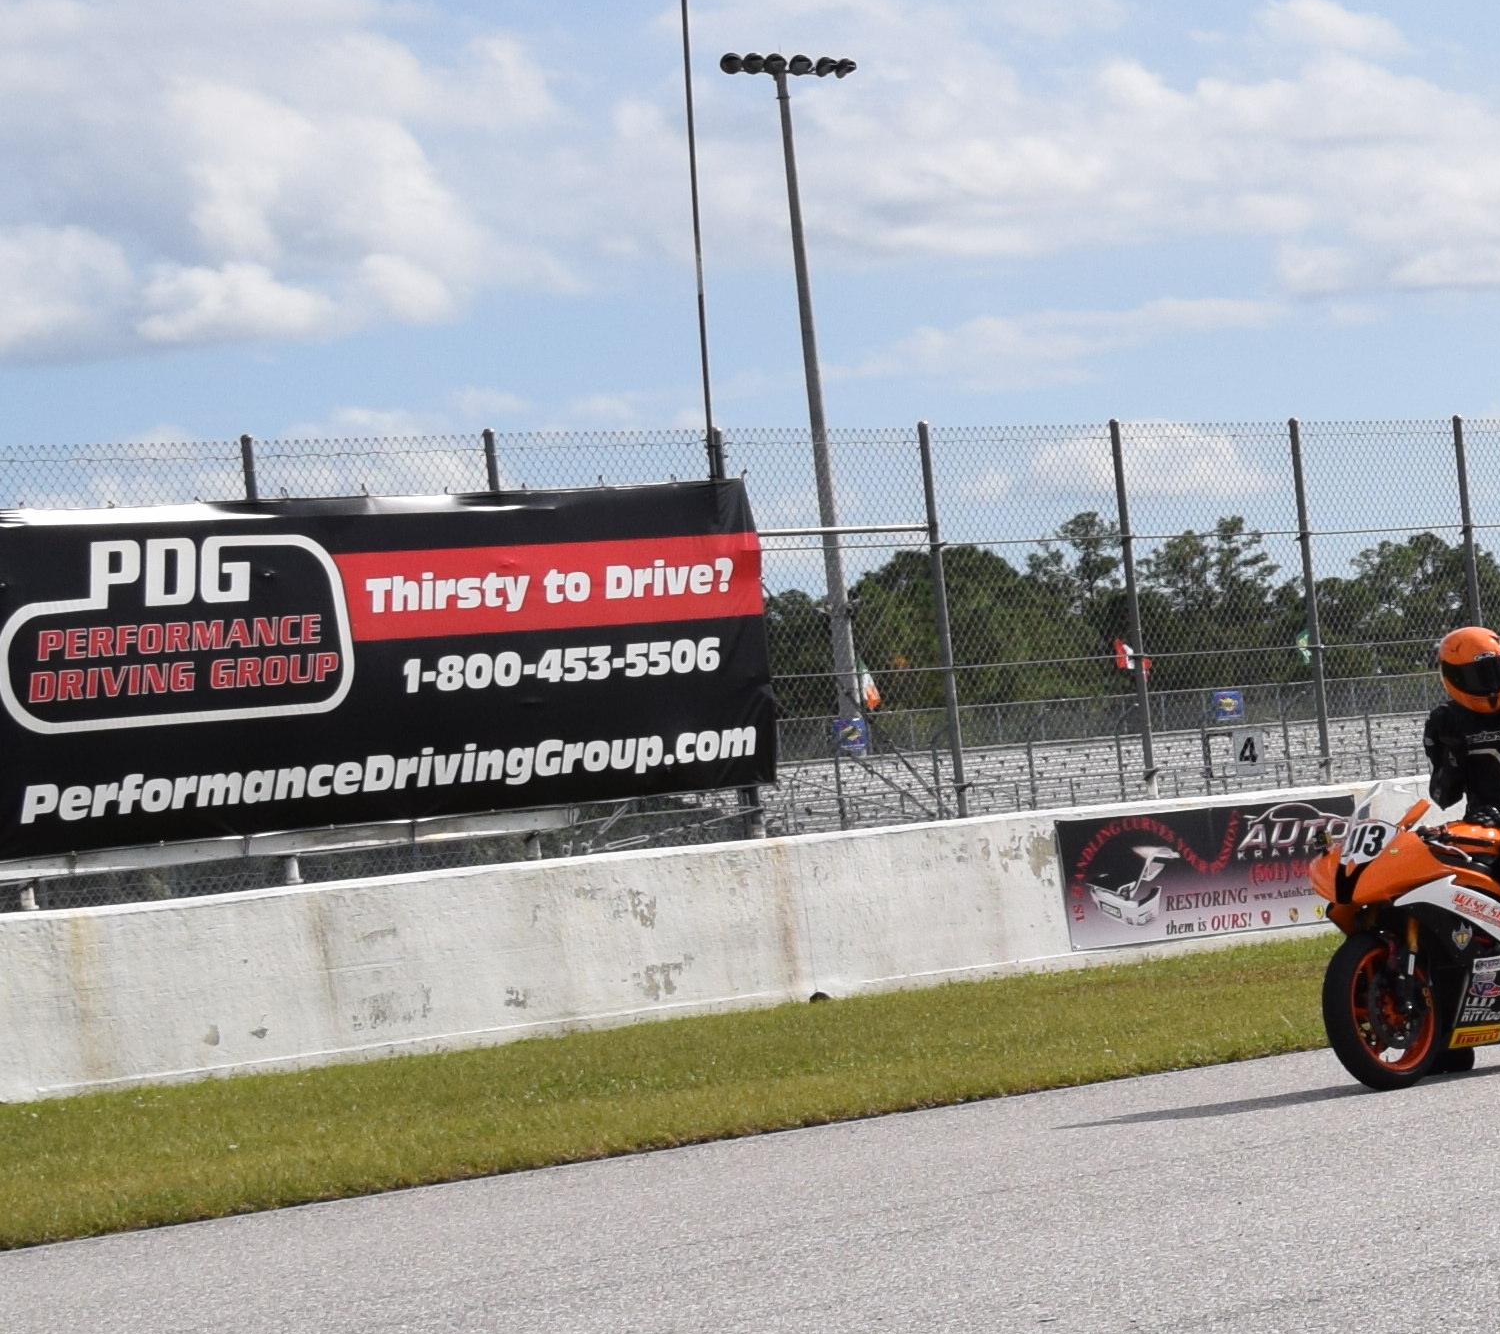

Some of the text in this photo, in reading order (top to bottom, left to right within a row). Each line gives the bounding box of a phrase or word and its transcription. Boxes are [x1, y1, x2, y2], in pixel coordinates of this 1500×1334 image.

[90, 535, 251, 609] PDG
[366, 557, 734, 614] Thirsty to Drive?
[37, 614, 322, 661] PERFORMANCE
[28, 652, 340, 703] DRIVING GROUP
[403, 637, 721, 694] 1-800-453-5506
[1239, 737, 1258, 763] 4
[20, 725, 757, 824] PerformanceDrivingGroup.com
[1121, 816, 1177, 843] CURVES
[1237, 818, 1350, 851] AUTO
[1165, 886, 1249, 913] RESTORING
[1165, 911, 1253, 936] them is OURS!
